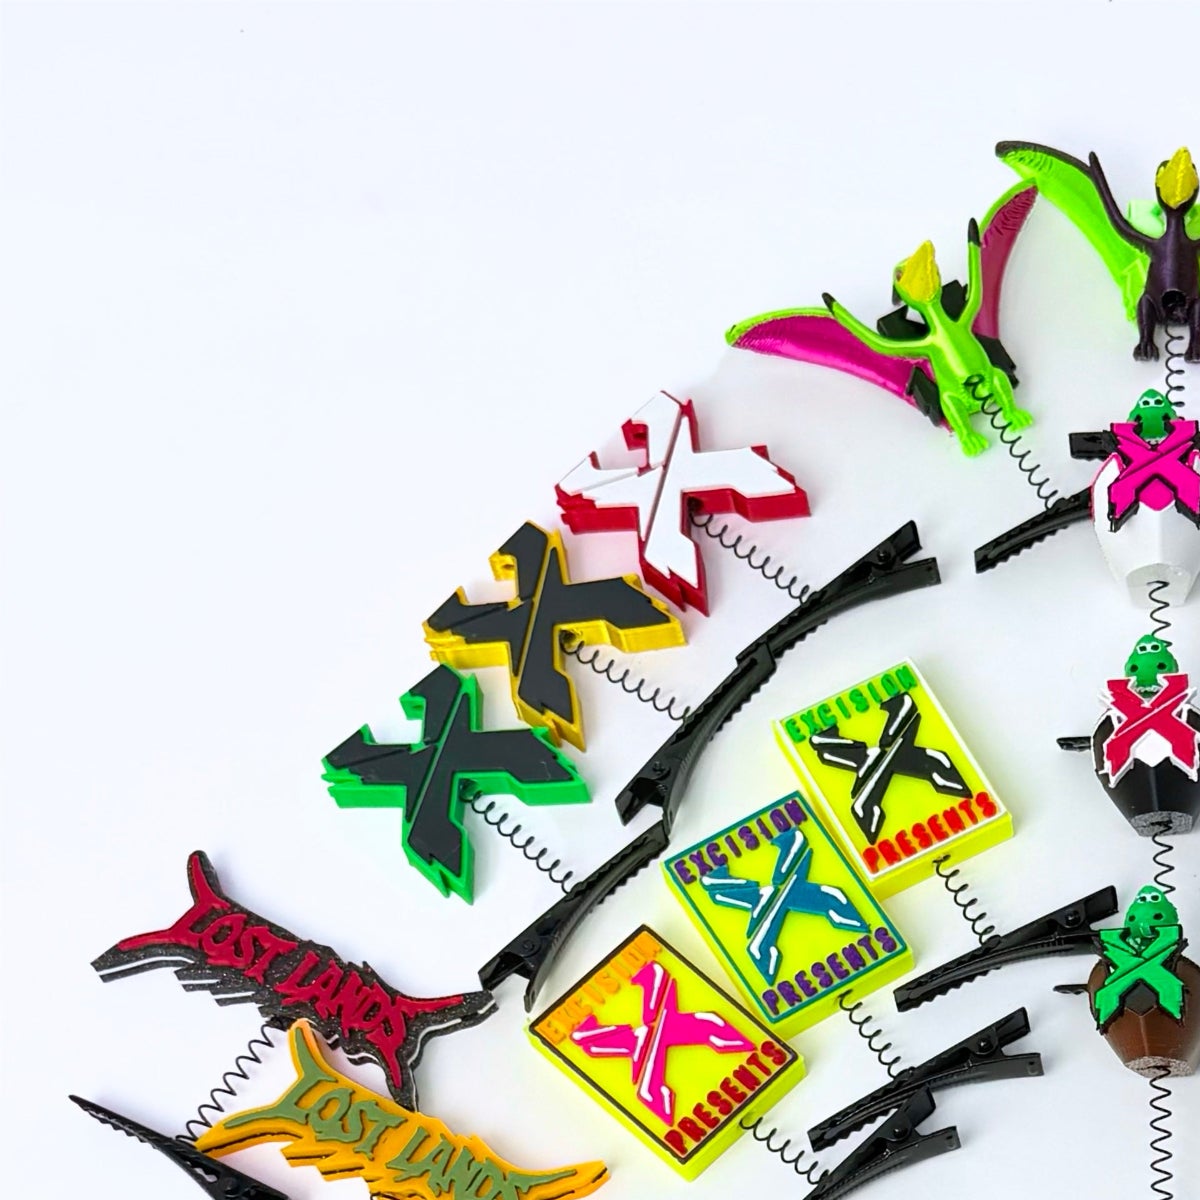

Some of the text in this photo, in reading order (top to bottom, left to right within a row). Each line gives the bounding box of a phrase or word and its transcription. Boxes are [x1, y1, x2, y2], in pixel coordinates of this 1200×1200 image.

[785, 665, 918, 743] EXCISION
[674, 799, 808, 884] EXCISION
[862, 791, 998, 875] PRESENTS
[117, 853, 464, 1089] LOST LANDS
[762, 926, 897, 1016] PRESENTS
[224, 1027, 406, 1160] LOST
[664, 1041, 787, 1156] PRESENTS
